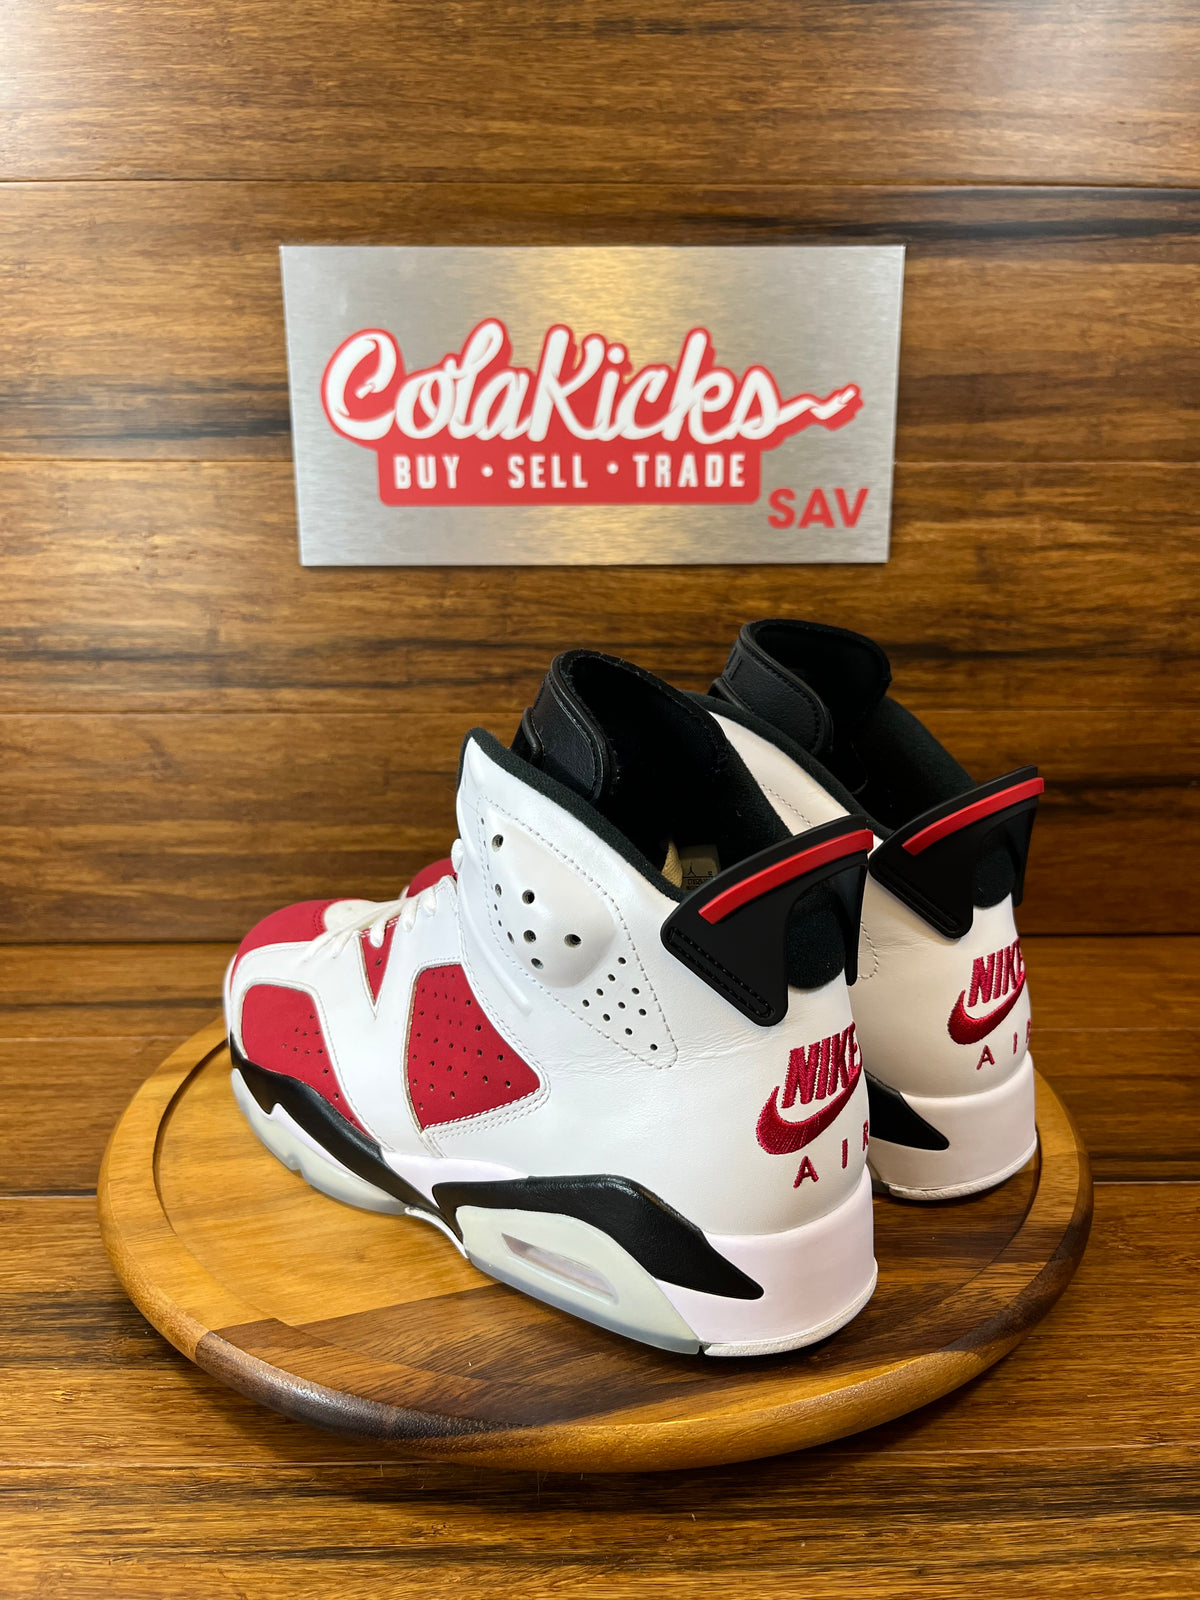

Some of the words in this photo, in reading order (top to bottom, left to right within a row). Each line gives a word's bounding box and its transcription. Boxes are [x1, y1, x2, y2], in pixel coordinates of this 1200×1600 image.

[323, 319, 862, 444] ColaKicks
[394, 454, 461, 490] BUY
[507, 454, 589, 489] SELL
[633, 453, 746, 488] TRADE
[767, 487, 869, 529] SAV
[781, 1021, 862, 1108] NIKE
[793, 1120, 869, 1188] AIR
